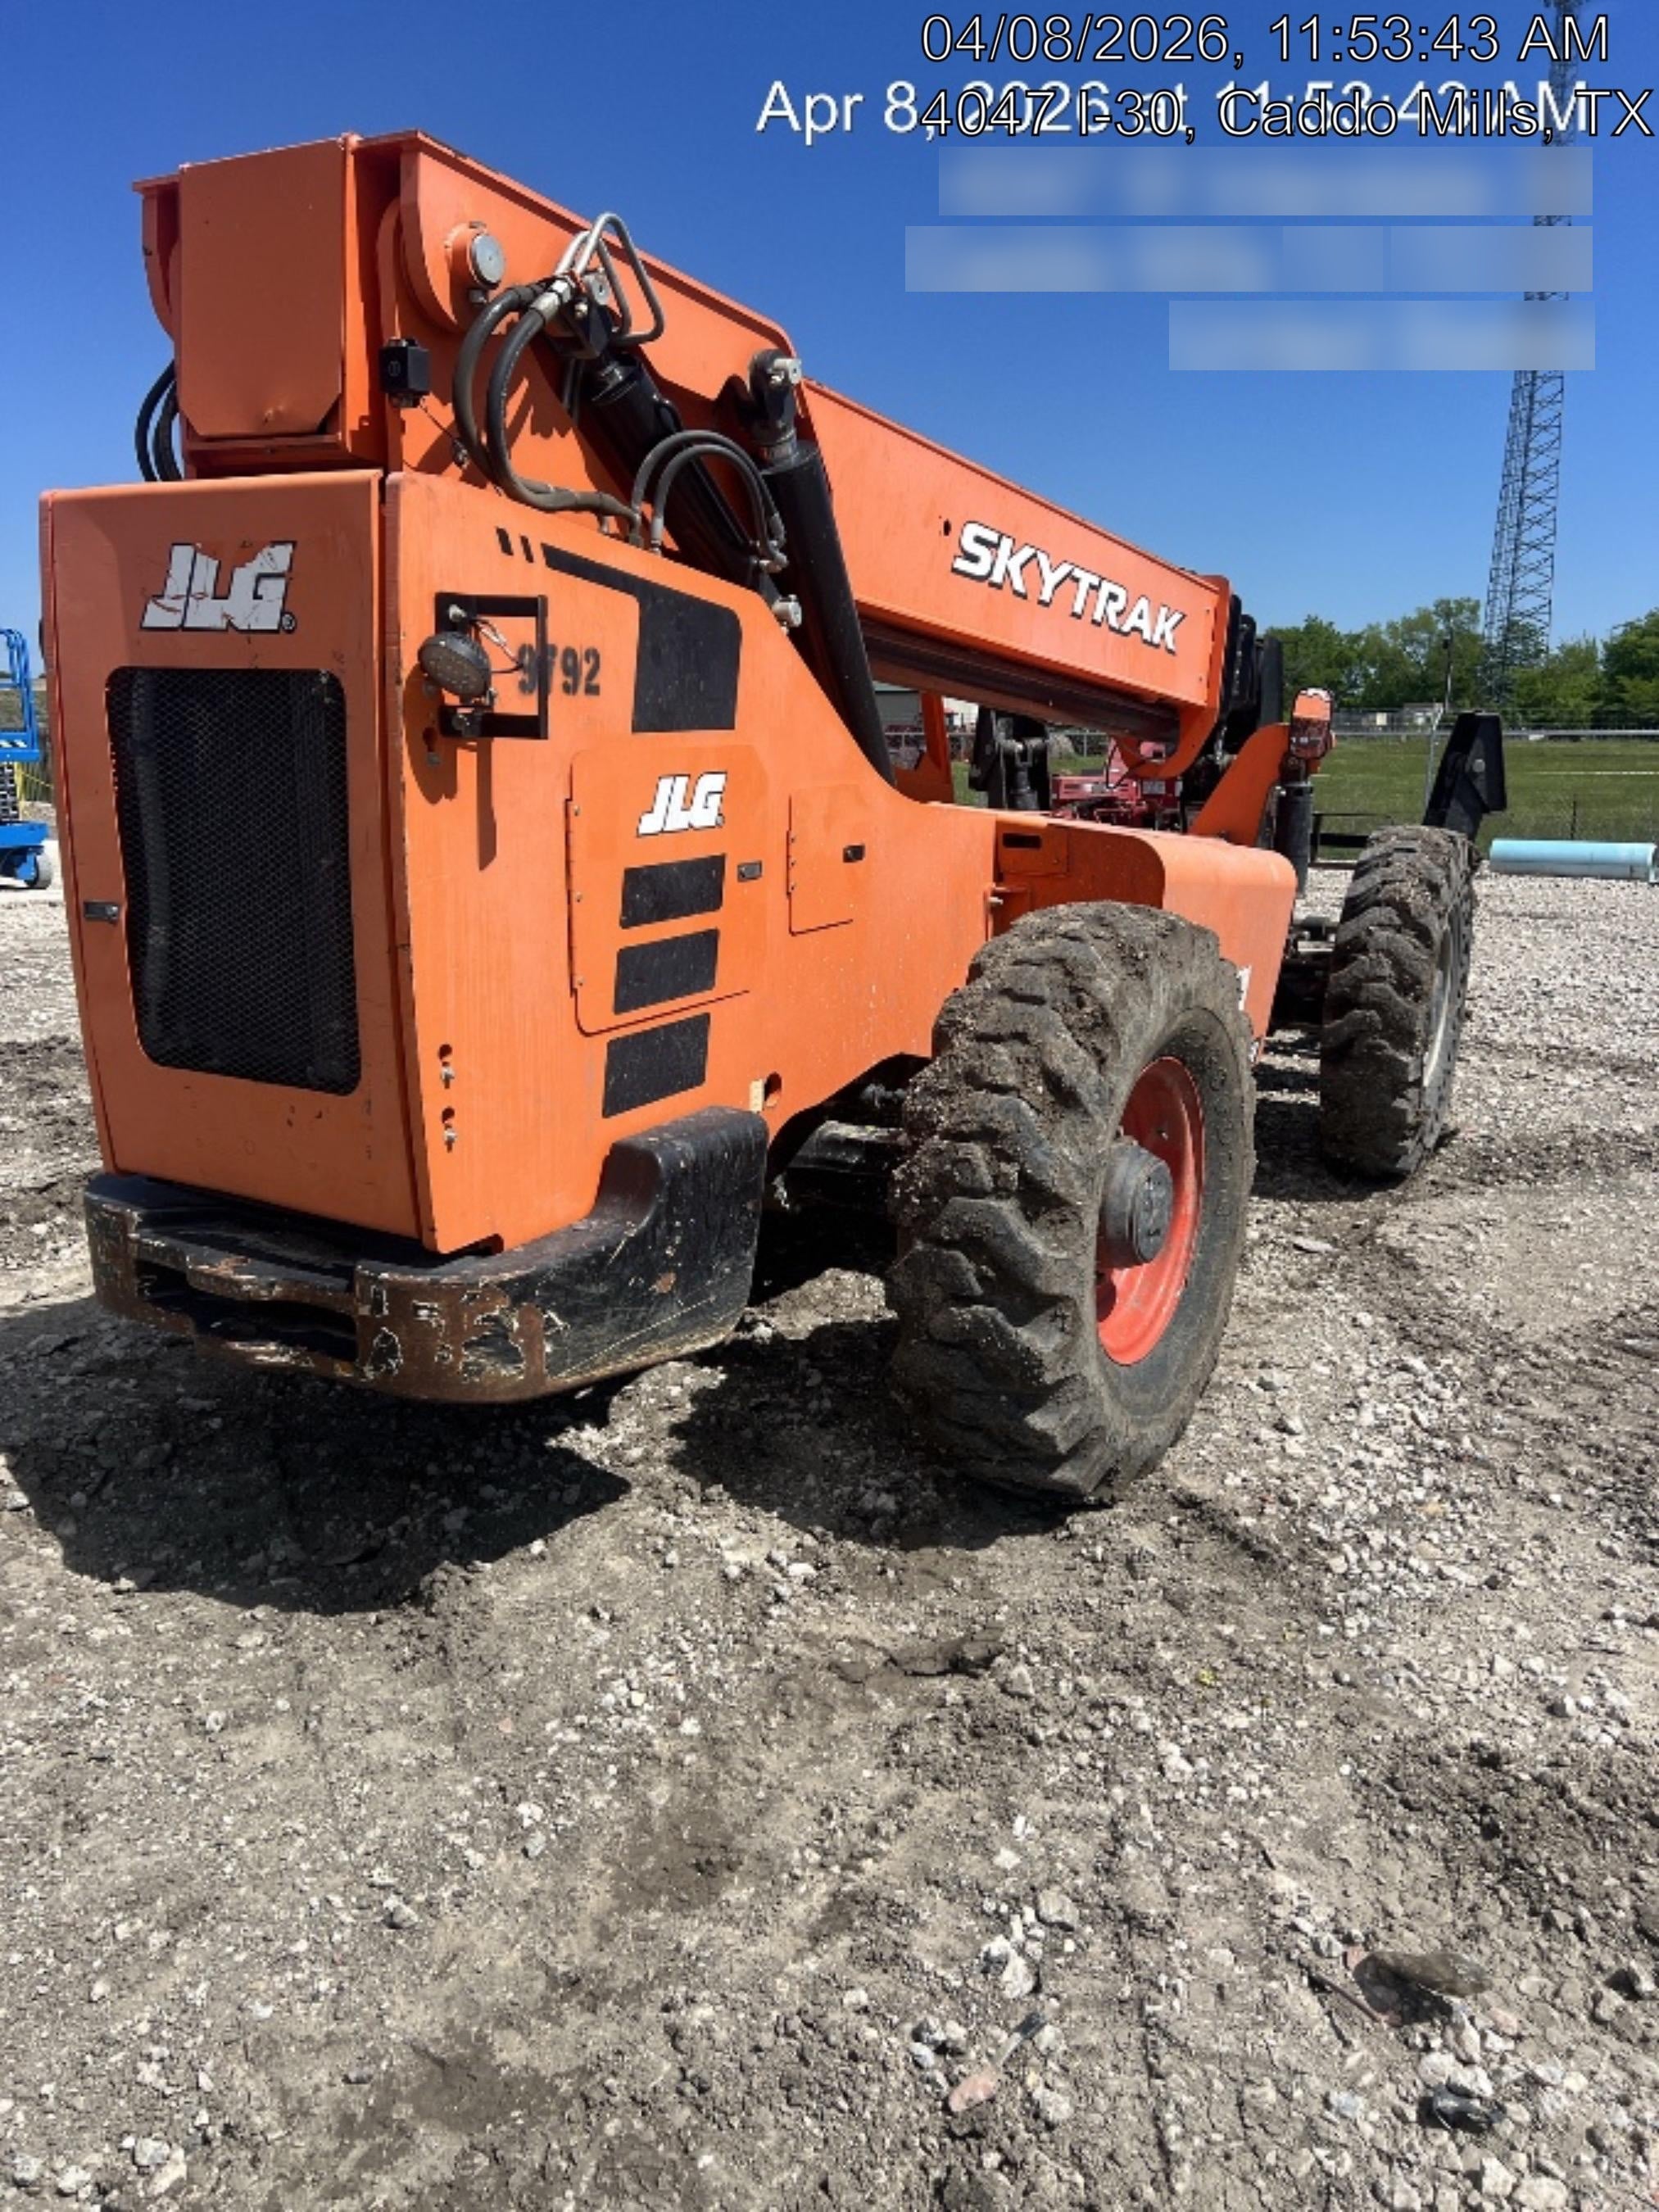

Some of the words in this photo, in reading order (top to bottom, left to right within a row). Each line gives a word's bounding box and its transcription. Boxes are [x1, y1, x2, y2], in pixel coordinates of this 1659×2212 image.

[140, 540, 297, 634] JLG
[951, 520, 1185, 655] SKYTRAK
[637, 771, 728, 836] JLG
